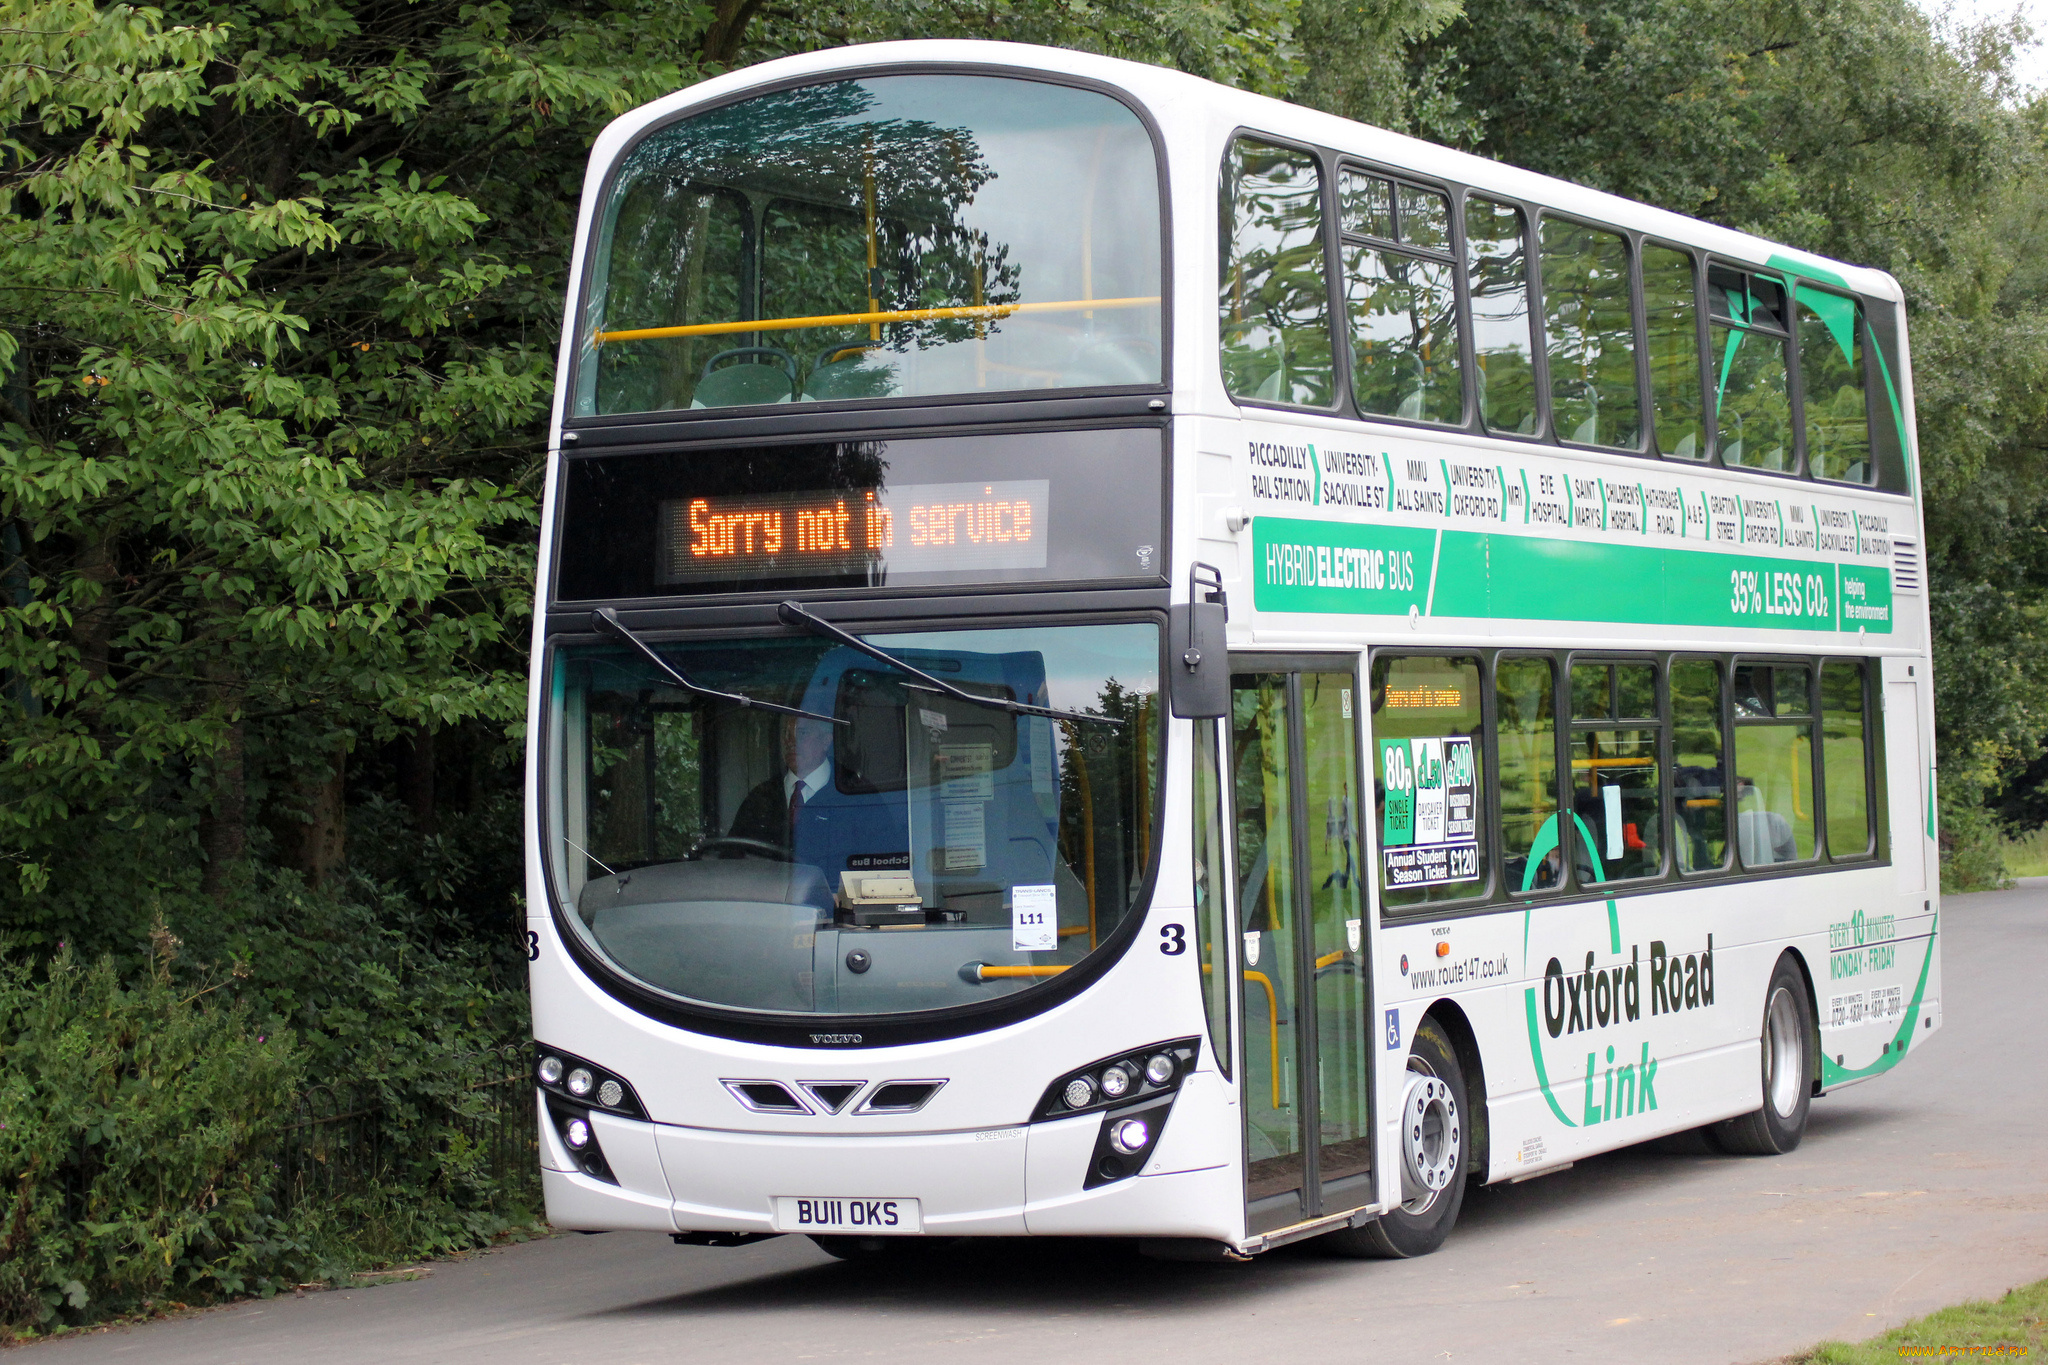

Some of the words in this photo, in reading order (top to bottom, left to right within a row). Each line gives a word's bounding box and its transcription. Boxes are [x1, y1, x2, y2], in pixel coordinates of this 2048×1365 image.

[1249, 442, 1307, 469] PICCADILLY
[1406, 460, 1428, 482] MMU
[1252, 475, 1273, 499] RAIL
[1274, 476, 1311, 503] STATION
[1323, 481, 1372, 507] SACKVILLE
[1374, 486, 1385, 509] ST
[1539, 474, 1555, 495] EYE
[1575, 479, 1596, 500] SAINT
[1605, 483, 1640, 506] CHILDREN'S
[1397, 488, 1412, 511] ALL
[1413, 490, 1443, 514] SAINTS
[1454, 495, 1486, 517] OXFORD
[1487, 498, 1498, 518] RD
[1508, 485, 1523, 507] MRI
[1645, 488, 1679, 511] HATHERSAGE
[1710, 495, 1737, 517] GRAFTON
[690, 499, 781, 556] Sorry
[798, 499, 851, 551] not
[866, 491, 893, 549] in
[910, 486, 1031, 546] service
[1532, 502, 1567, 525] HOSPITAL
[1575, 506, 1601, 528] MARY'S
[1611, 509, 1639, 532] HOSPITAL
[1657, 514, 1675, 535] ROAD
[1687, 504, 1692, 522] A
[1698, 506, 1703, 524] E
[1789, 504, 1803, 523] MMU
[1859, 514, 1888, 534] PICCADILLY
[1716, 521, 1736, 541] STREET
[1746, 524, 1769, 543] OXFORD
[1770, 526, 1778, 545] RD
[1784, 527, 1795, 546] ALL
[1795, 528, 1815, 549] SAINTS
[1820, 532, 1846, 552] SACKVILLE
[1847, 536, 1855, 553] ST
[1861, 537, 1871, 554] RAIL
[1872, 538, 1891, 556] STATION
[1389, 550, 1414, 592] BUS
[1730, 569, 1761, 615] 35%
[1765, 572, 1801, 616] LESS
[1844, 577, 1865, 600] helping
[1845, 602, 1854, 619] the
[1855, 602, 1888, 621] environment
[1385, 745, 1412, 797] 80p
[1389, 799, 1409, 815] SINGLE
[1418, 801, 1443, 816] DAYSAVER
[1390, 815, 1409, 830] TICKET
[1422, 816, 1440, 831] TICKET
[1388, 851, 1415, 868] Annual
[1416, 849, 1447, 865] Student
[1450, 849, 1476, 876] £120
[1394, 868, 1422, 883] Season
[1424, 865, 1447, 880] Ticket
[1020, 912, 1044, 925] L11
[1830, 922, 1850, 948] EVERY
[1851, 909, 1865, 946] 10
[1867, 914, 1895, 942] MINUTES
[526, 930, 540, 961] 3
[1159, 923, 1186, 956] 3
[1411, 953, 1509, 990] www.route147.co.uk
[1830, 951, 1863, 980] MONDAY
[1869, 945, 1895, 972] FRIDAY
[1544, 944, 1640, 1039] Oxford
[1650, 933, 1714, 1016] Road
[809, 1034, 863, 1044] VOLVO
[1583, 1041, 1658, 1127] Link
[975, 1130, 1022, 1141] SCREENWASH
[850, 1201, 898, 1226] OKS
